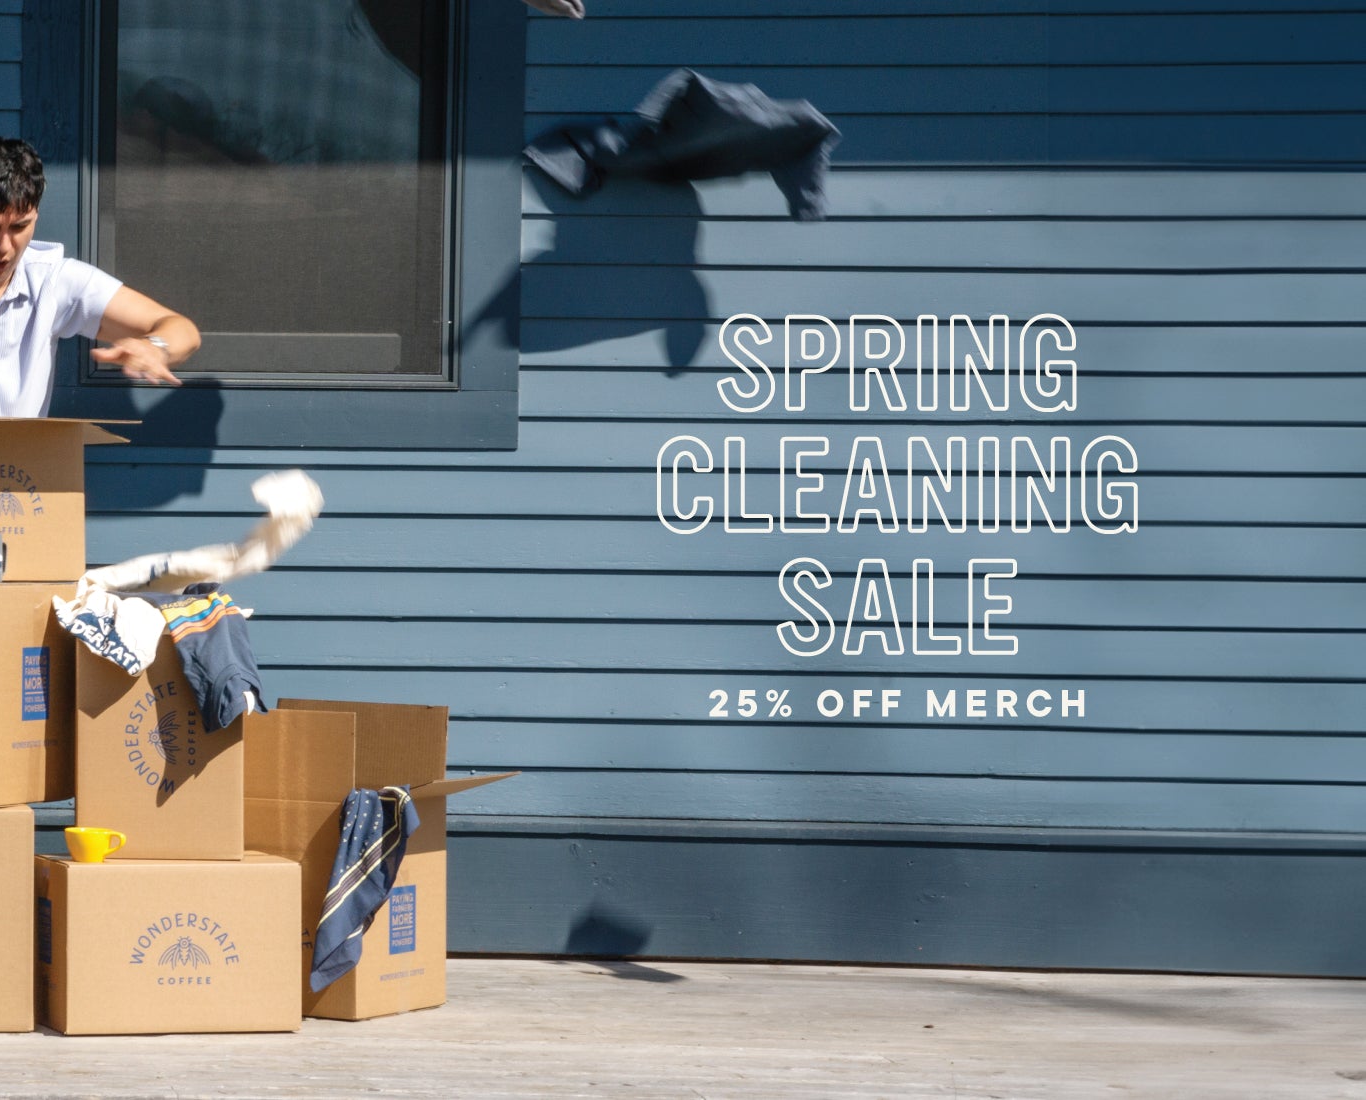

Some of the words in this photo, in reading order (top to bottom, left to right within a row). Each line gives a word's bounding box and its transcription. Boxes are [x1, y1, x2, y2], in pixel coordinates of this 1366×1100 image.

[25, 676, 47, 691] MORE
[125, 681, 178, 794] WONDERSTATE
[188, 709, 197, 766] COFFEE
[392, 912, 414, 926] MORE
[129, 913, 240, 966] WONDERSTATE
[157, 977, 212, 985] COFFEE
